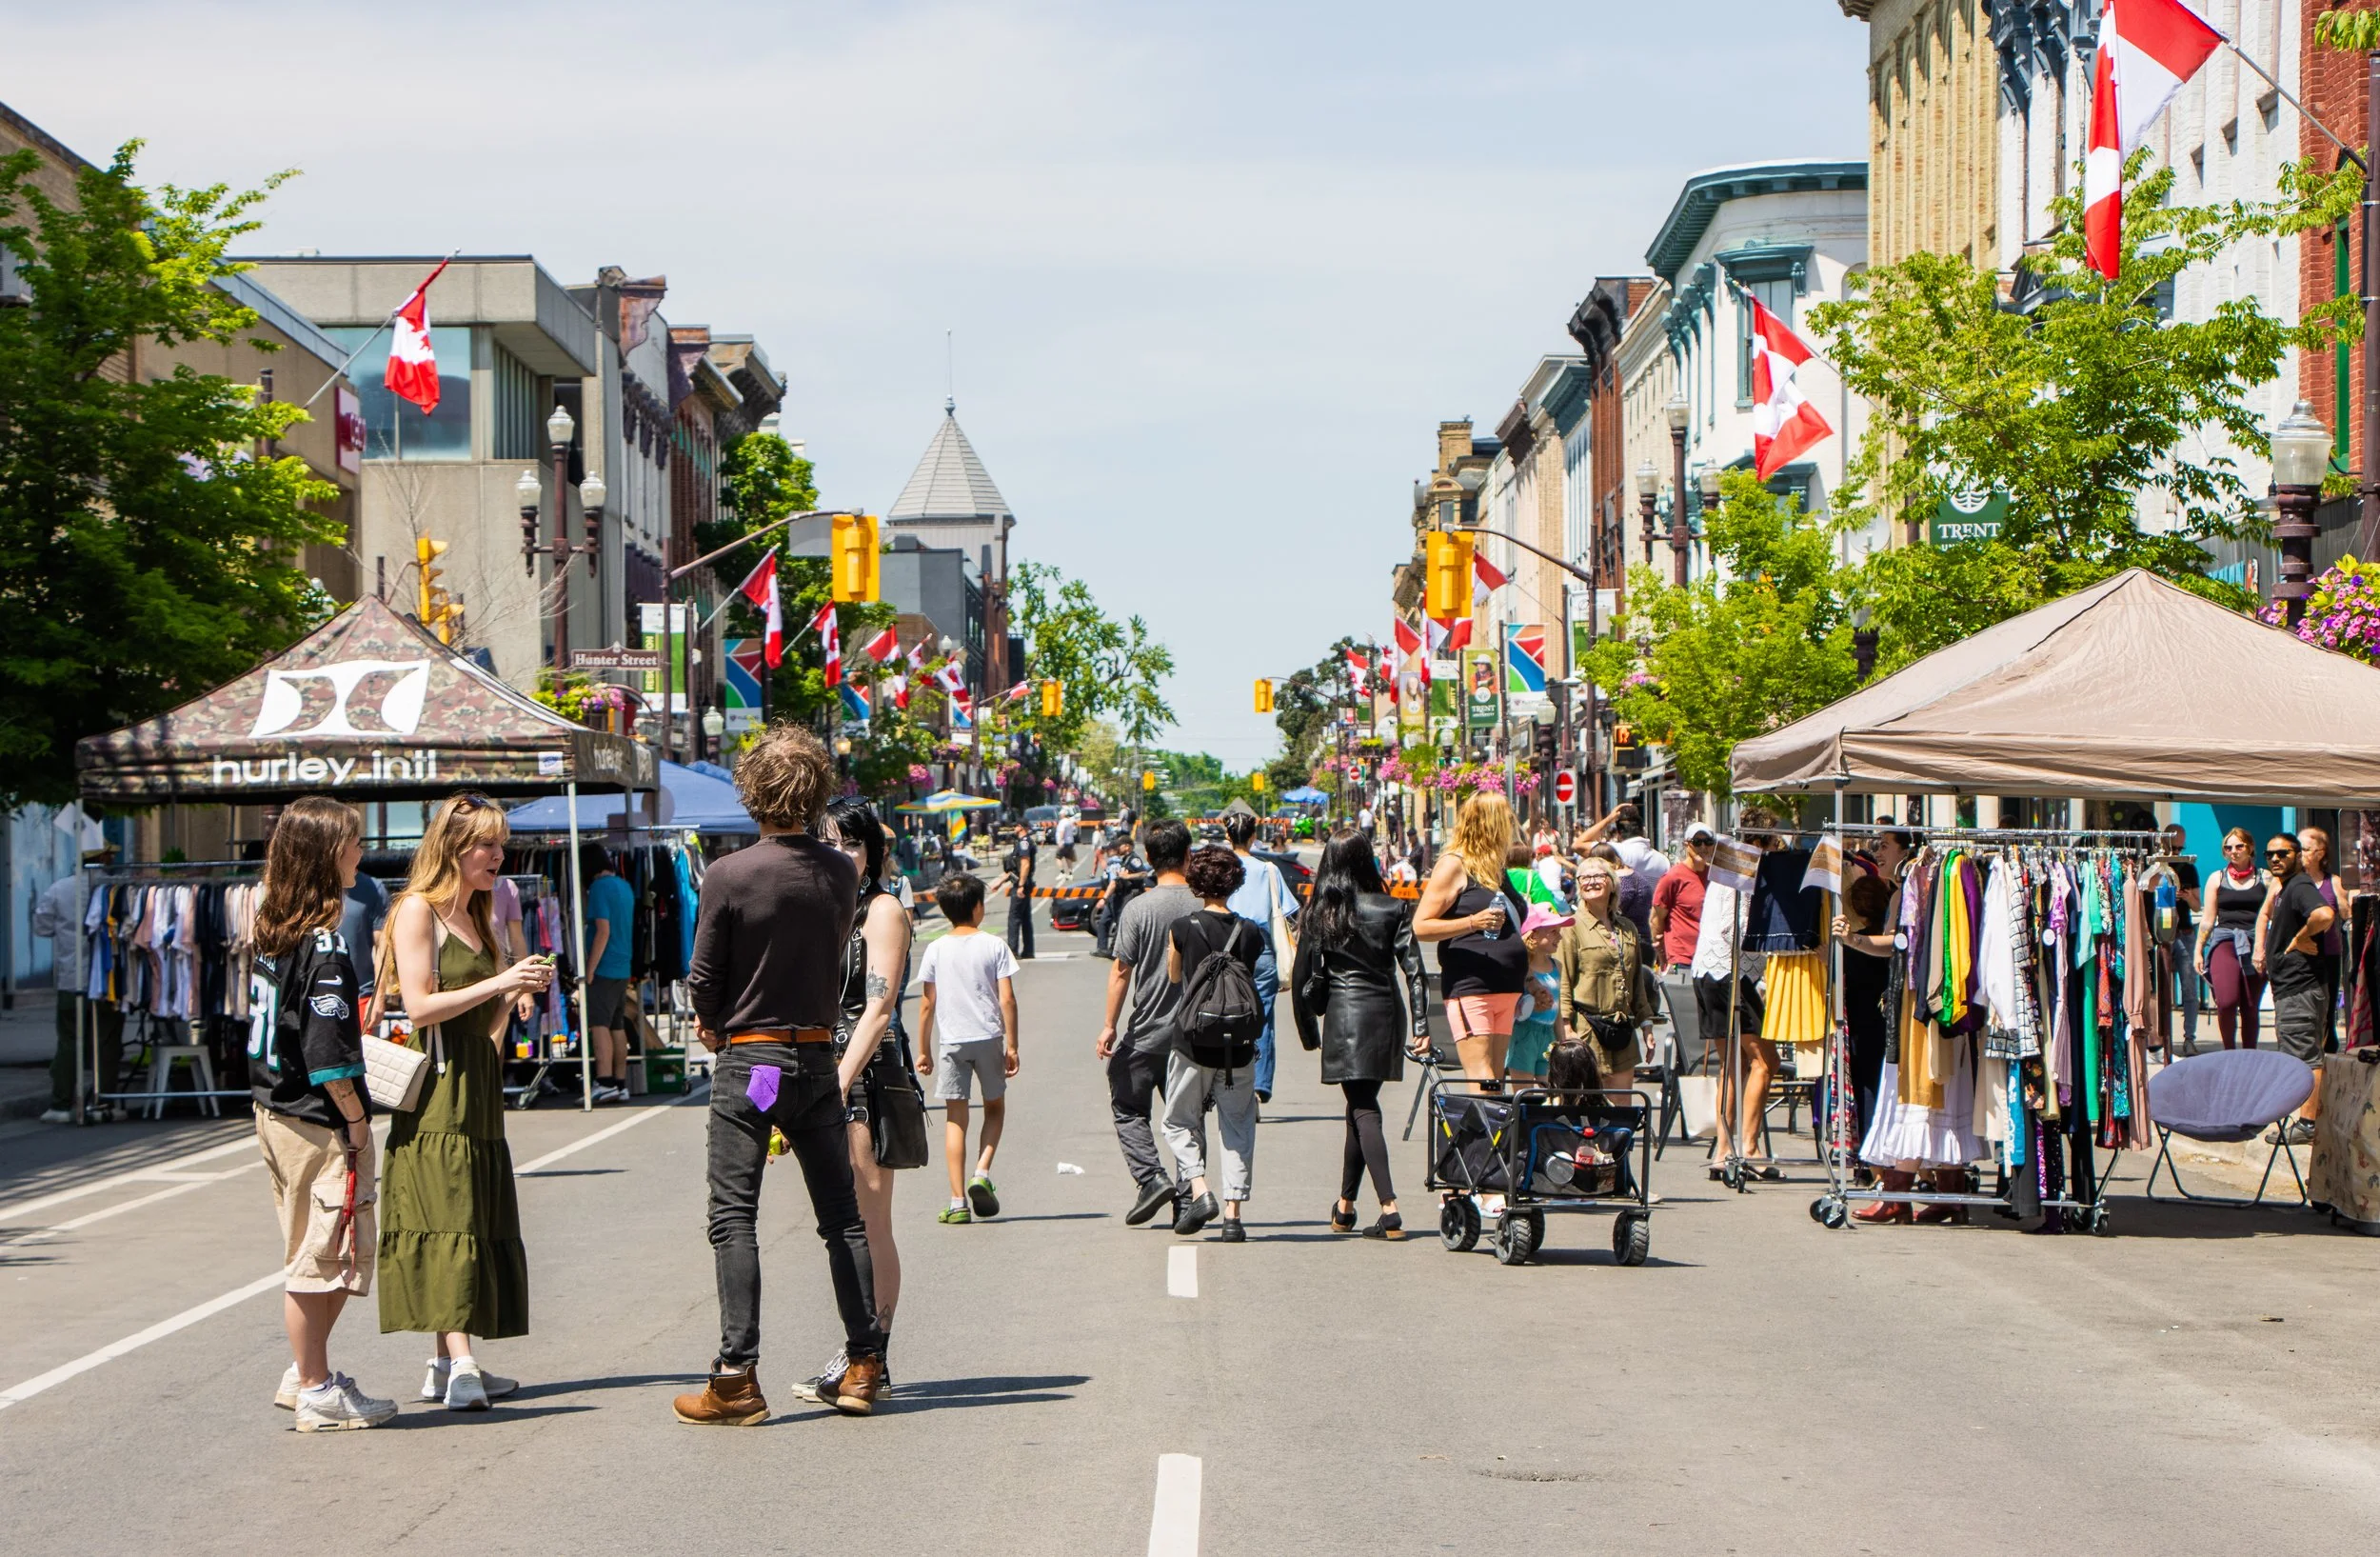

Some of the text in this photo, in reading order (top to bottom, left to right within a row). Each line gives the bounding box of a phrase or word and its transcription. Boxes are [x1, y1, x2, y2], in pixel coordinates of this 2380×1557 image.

[1937, 522, 2001, 540] TRENT
[574, 653, 658, 667] Hunter Street
[1471, 705, 1496, 713] TRENT
